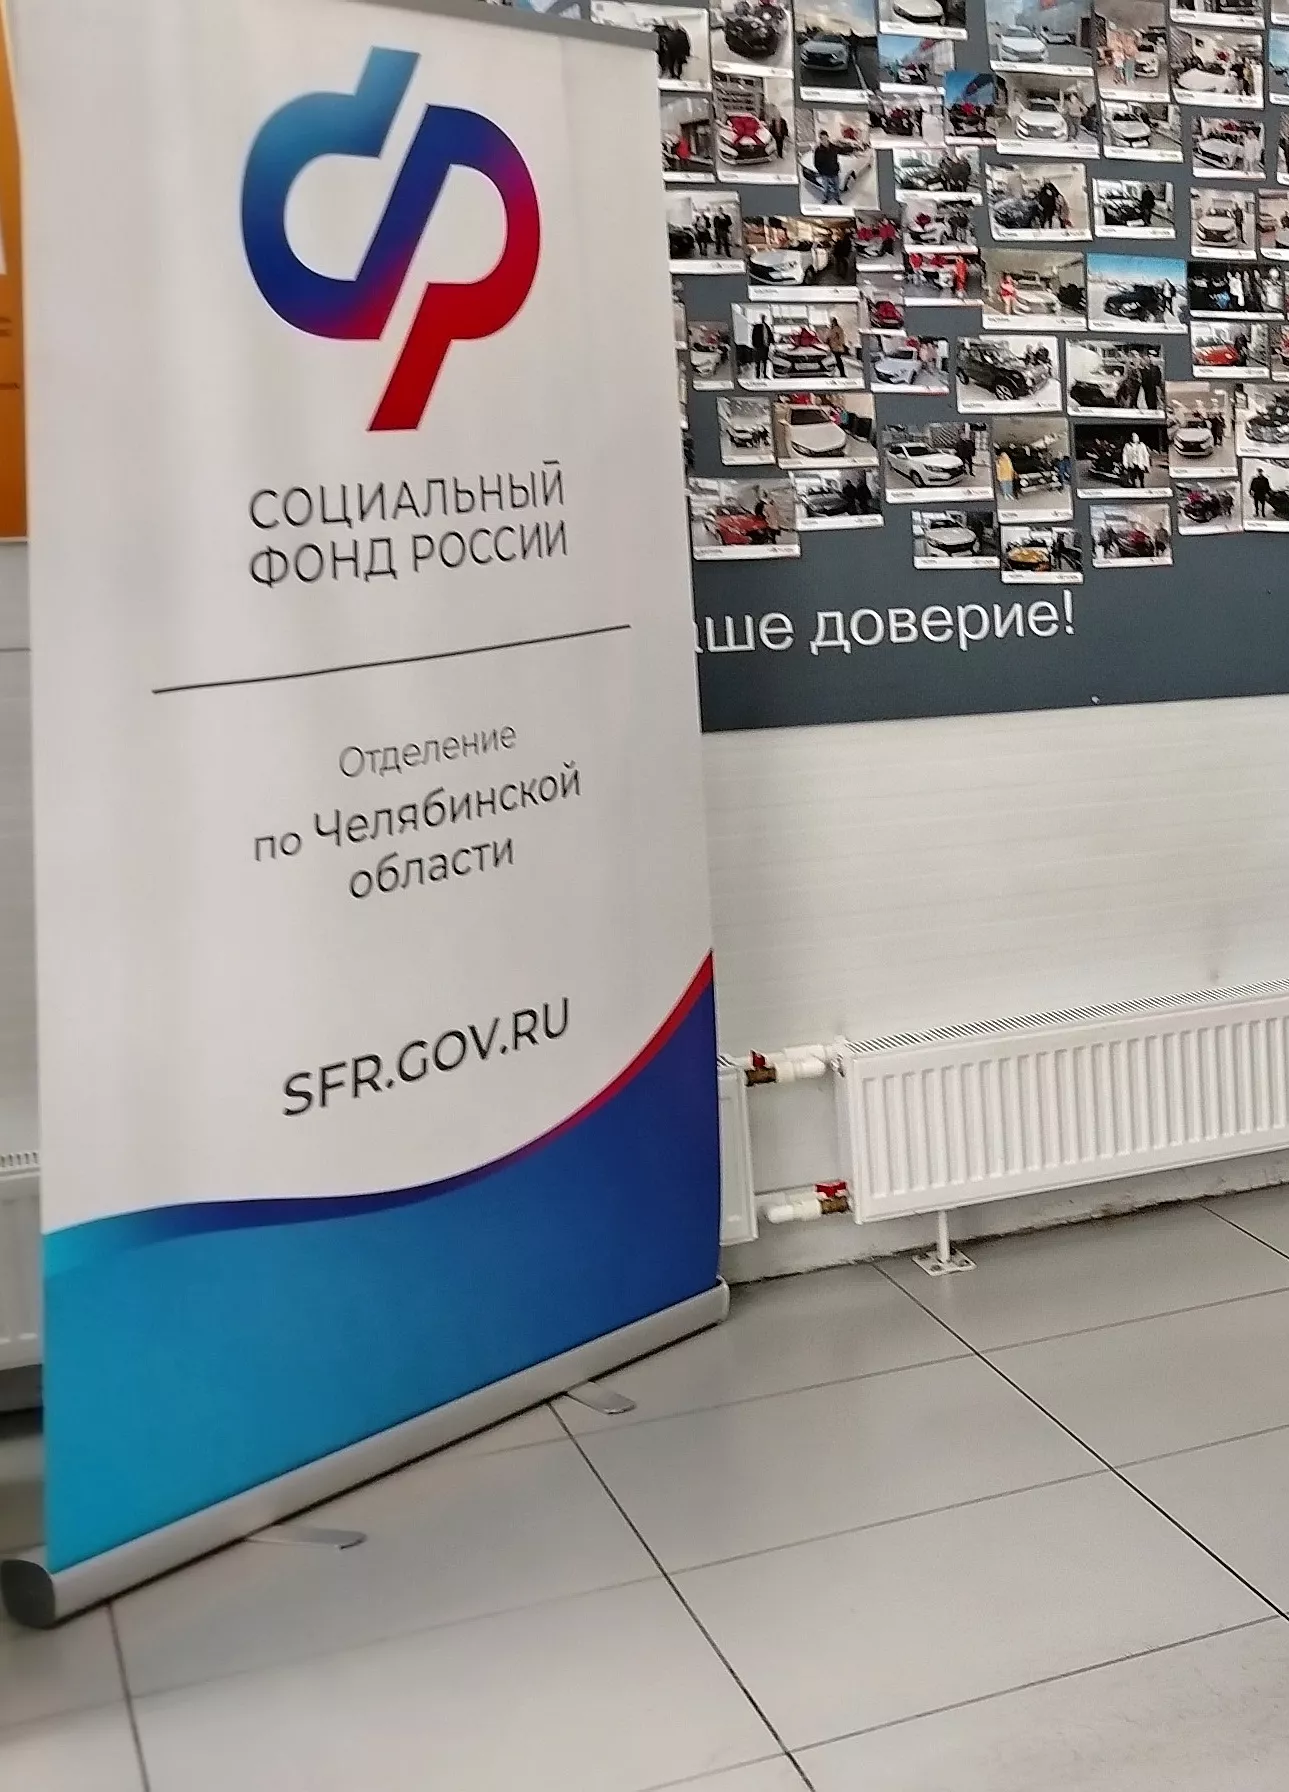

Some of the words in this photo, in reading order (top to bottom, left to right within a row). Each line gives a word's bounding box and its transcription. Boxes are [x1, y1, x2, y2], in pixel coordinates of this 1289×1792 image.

[247, 459, 565, 531] СОЦИАЛЬНЫЙ
[248, 536, 399, 590] ФОНД
[411, 519, 568, 574] РОССИИ
[694, 610, 795, 654] ше
[810, 589, 1076, 656] доверие!
[338, 722, 517, 779] Отделение
[253, 830, 303, 863] по
[312, 759, 582, 848] Челябинской
[347, 836, 515, 900] области
[281, 996, 571, 1118] SFR.GOV.RU
